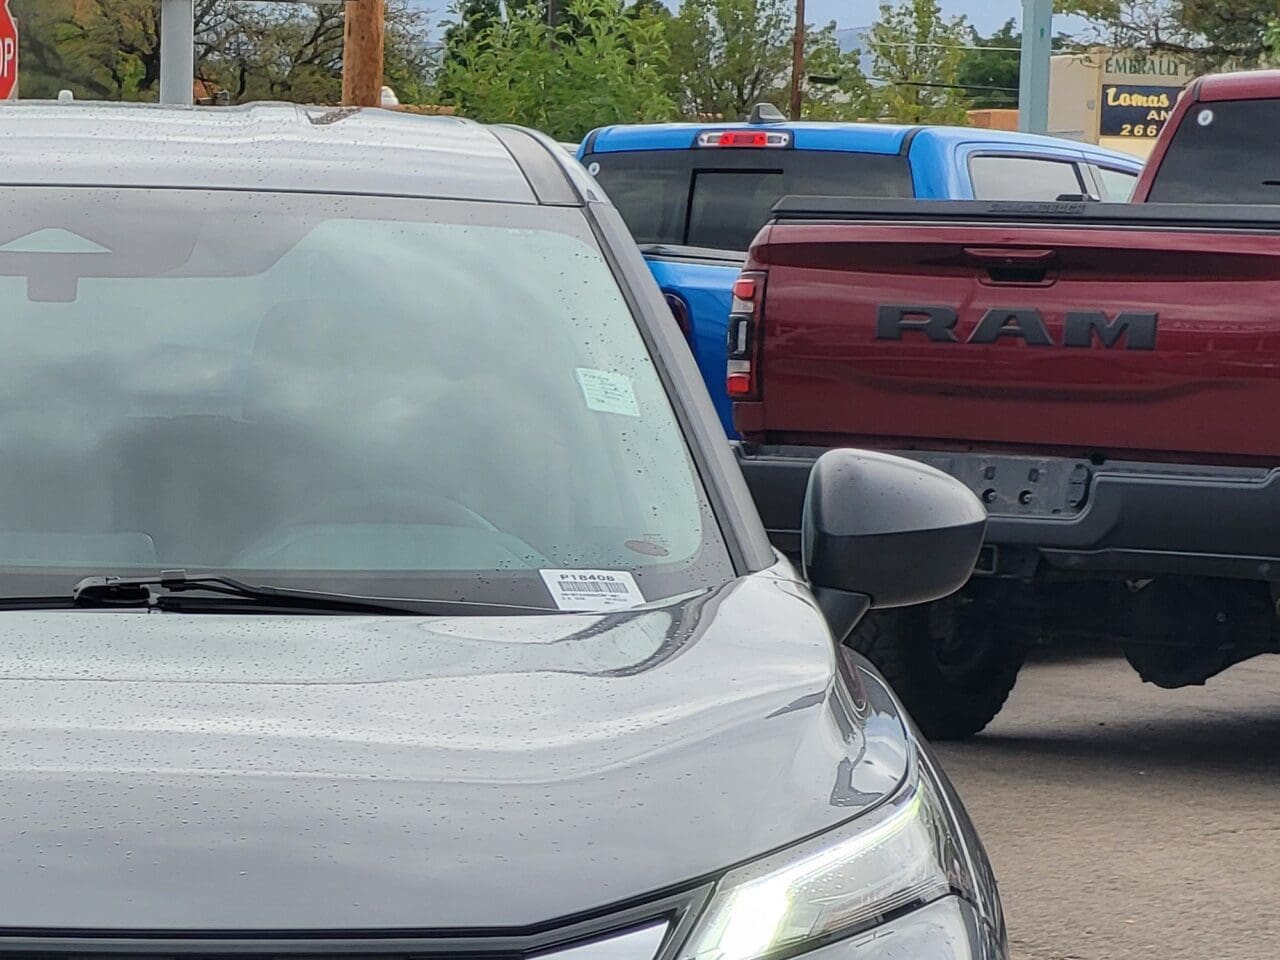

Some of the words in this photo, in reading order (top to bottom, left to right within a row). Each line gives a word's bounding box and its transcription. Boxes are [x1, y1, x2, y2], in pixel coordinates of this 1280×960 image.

[1106, 87, 1169, 107] Lomas
[1120, 124, 1157, 136] 266
[875, 304, 1158, 350] RAM
